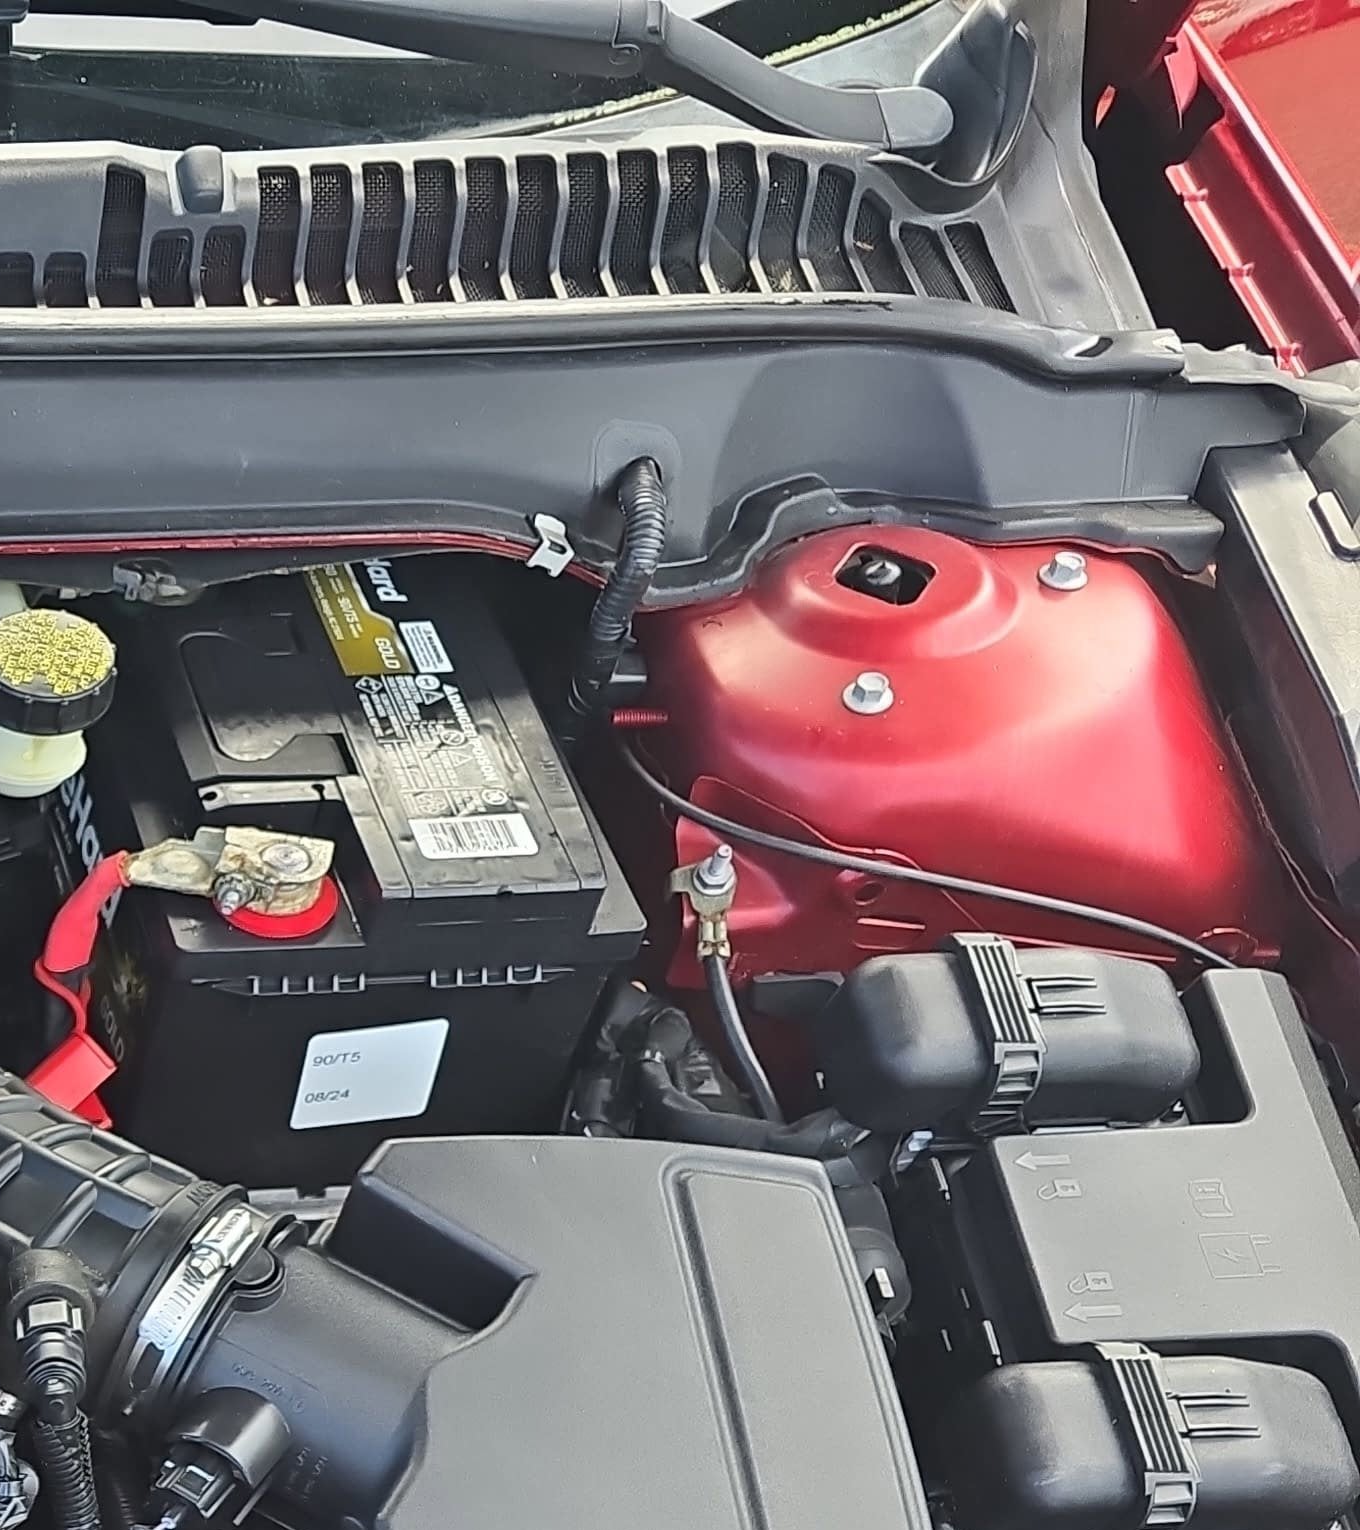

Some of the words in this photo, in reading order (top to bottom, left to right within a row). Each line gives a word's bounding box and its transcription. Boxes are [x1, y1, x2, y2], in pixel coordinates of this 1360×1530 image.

[375, 637, 401, 669] GOLD
[100, 995, 124, 1063] GOLD
[312, 1051, 361, 1067] 90/T5
[304, 1088, 351, 1104] 08/24
